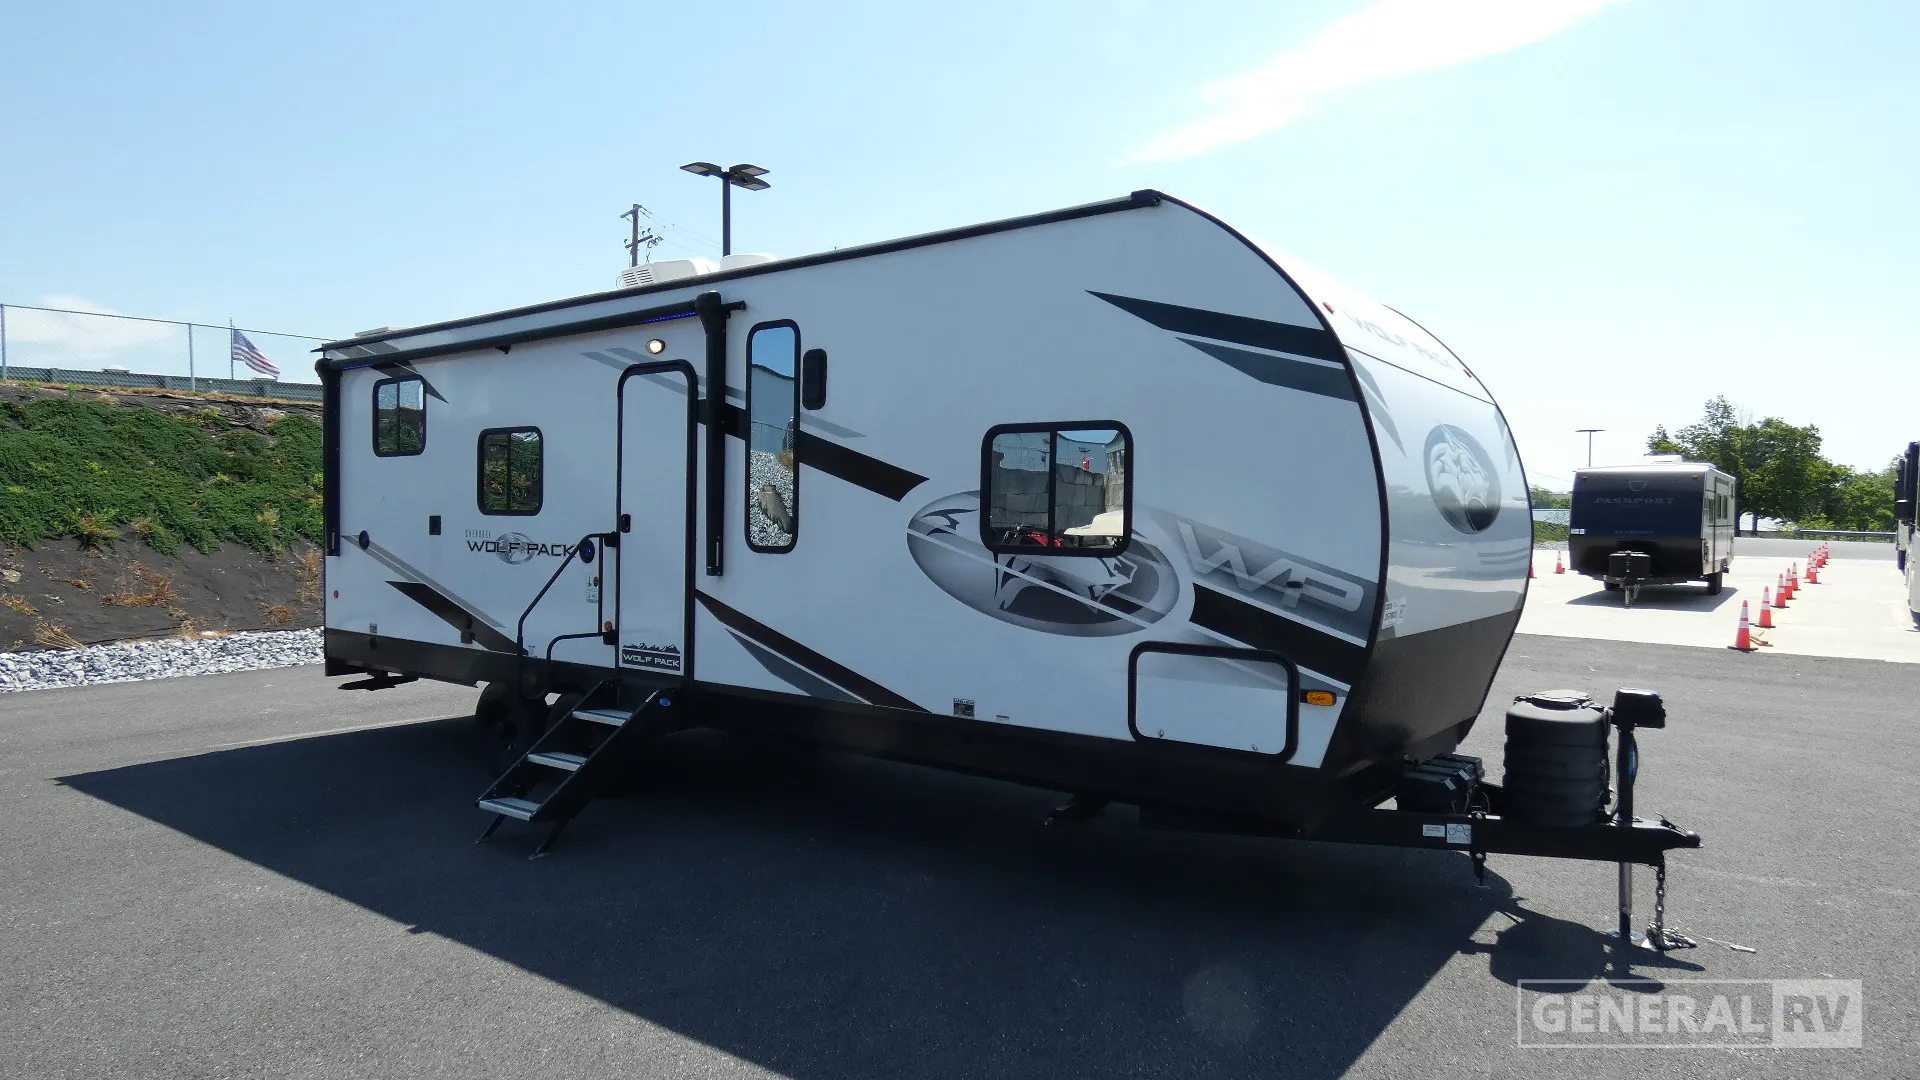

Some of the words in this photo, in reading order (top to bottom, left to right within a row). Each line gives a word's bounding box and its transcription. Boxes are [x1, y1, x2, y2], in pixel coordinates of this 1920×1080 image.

[1595, 496, 1676, 504] PASSPORT
[467, 540, 521, 554] WOLF
[526, 543, 577, 558] PACK
[623, 653, 652, 663] WOLF
[654, 657, 680, 667] PACK
